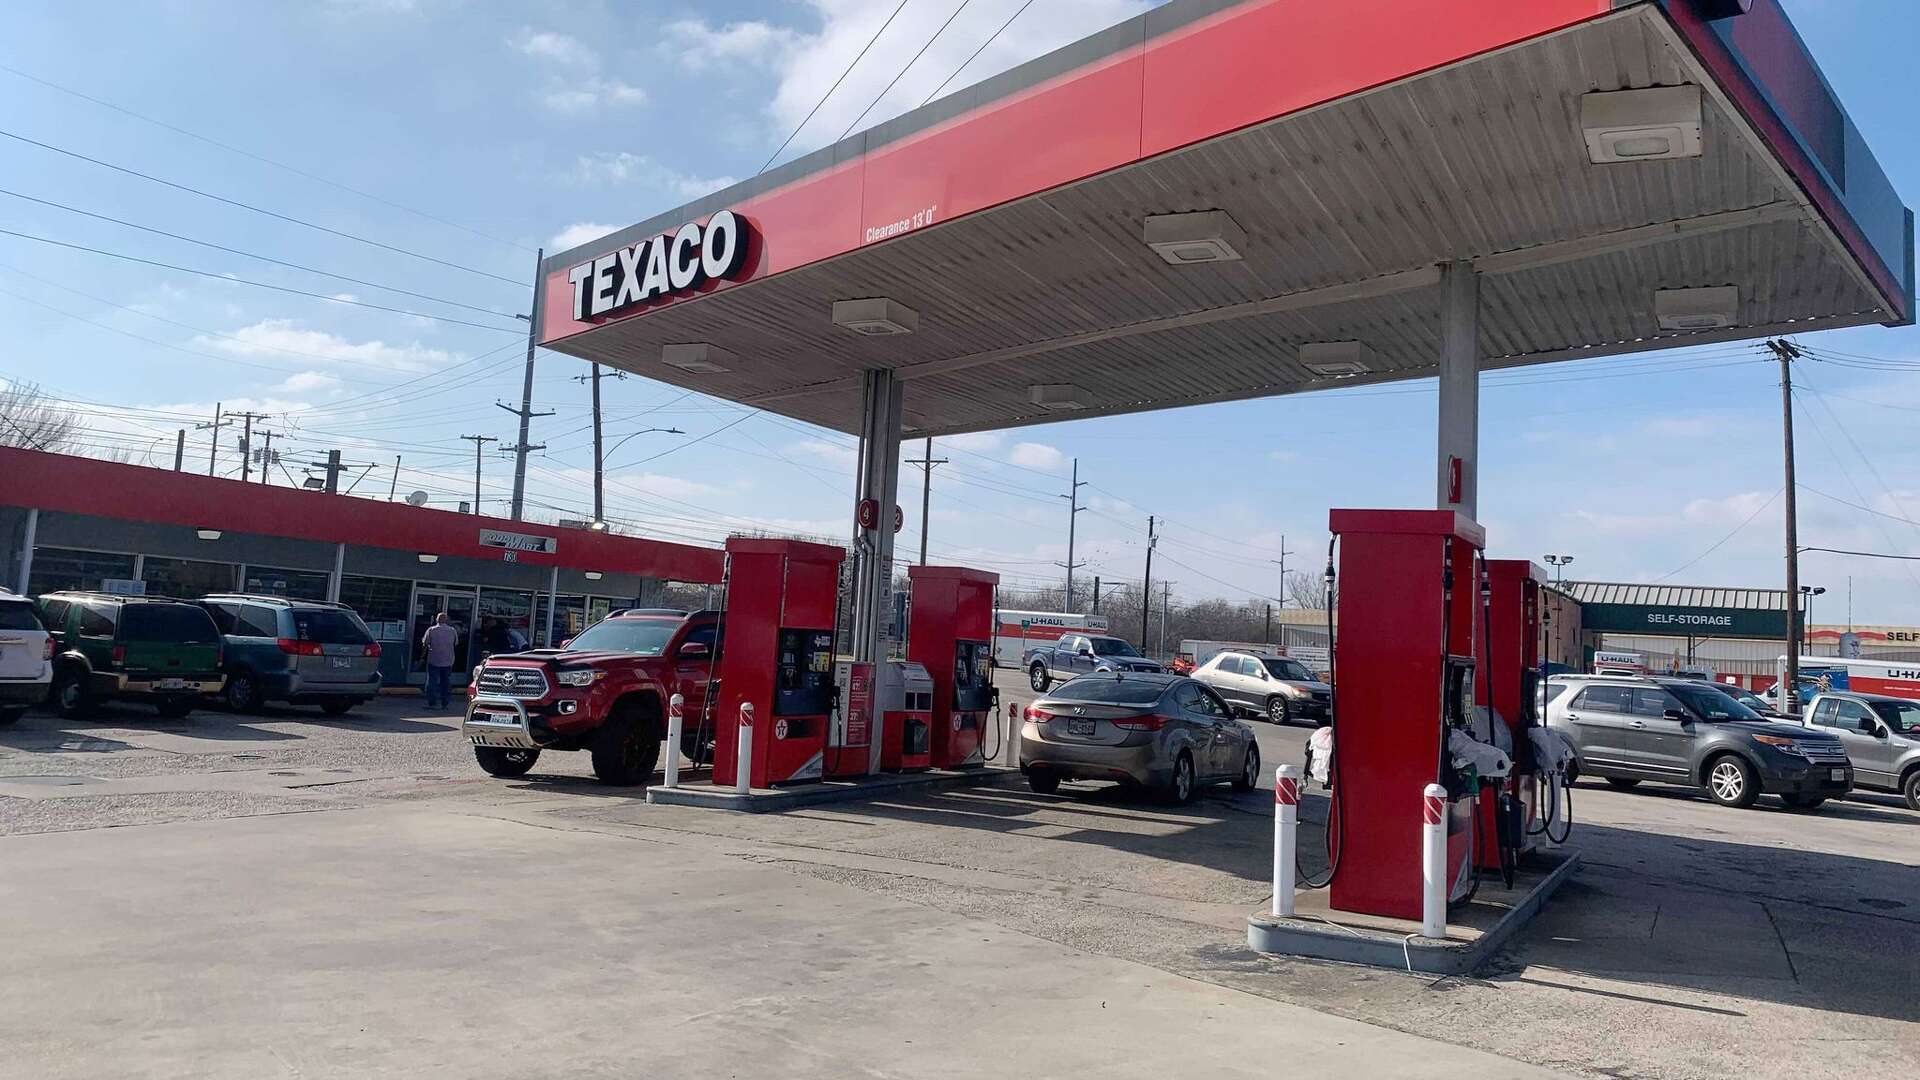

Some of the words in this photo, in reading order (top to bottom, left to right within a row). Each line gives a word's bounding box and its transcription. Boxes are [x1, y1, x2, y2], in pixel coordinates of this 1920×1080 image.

[866, 218, 910, 242] Clearance
[568, 209, 740, 322] TEXACO
[863, 507, 870, 520] 4
[1030, 617, 1065, 627] U-HAUL
[1647, 613, 1732, 626] SELF-STORAGE
[1887, 631, 1920, 642] SELF
[1601, 655, 1636, 664] U-HAUL
